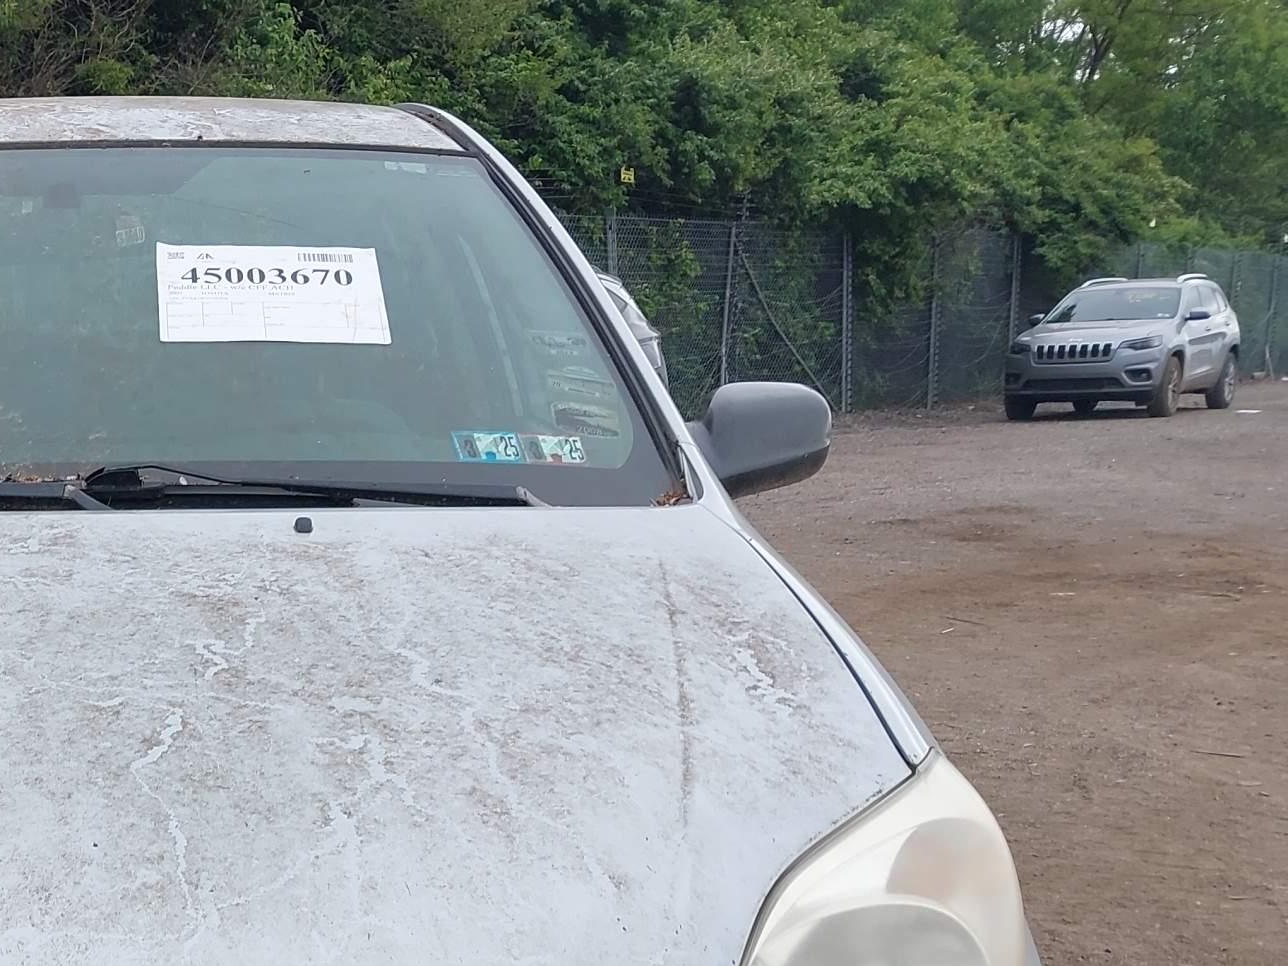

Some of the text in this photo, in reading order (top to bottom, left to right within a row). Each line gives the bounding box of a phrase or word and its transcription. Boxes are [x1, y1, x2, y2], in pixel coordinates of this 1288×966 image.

[181, 267, 353, 286] 45003670
[499, 436, 520, 457] 25
[564, 438, 585, 460] 25
